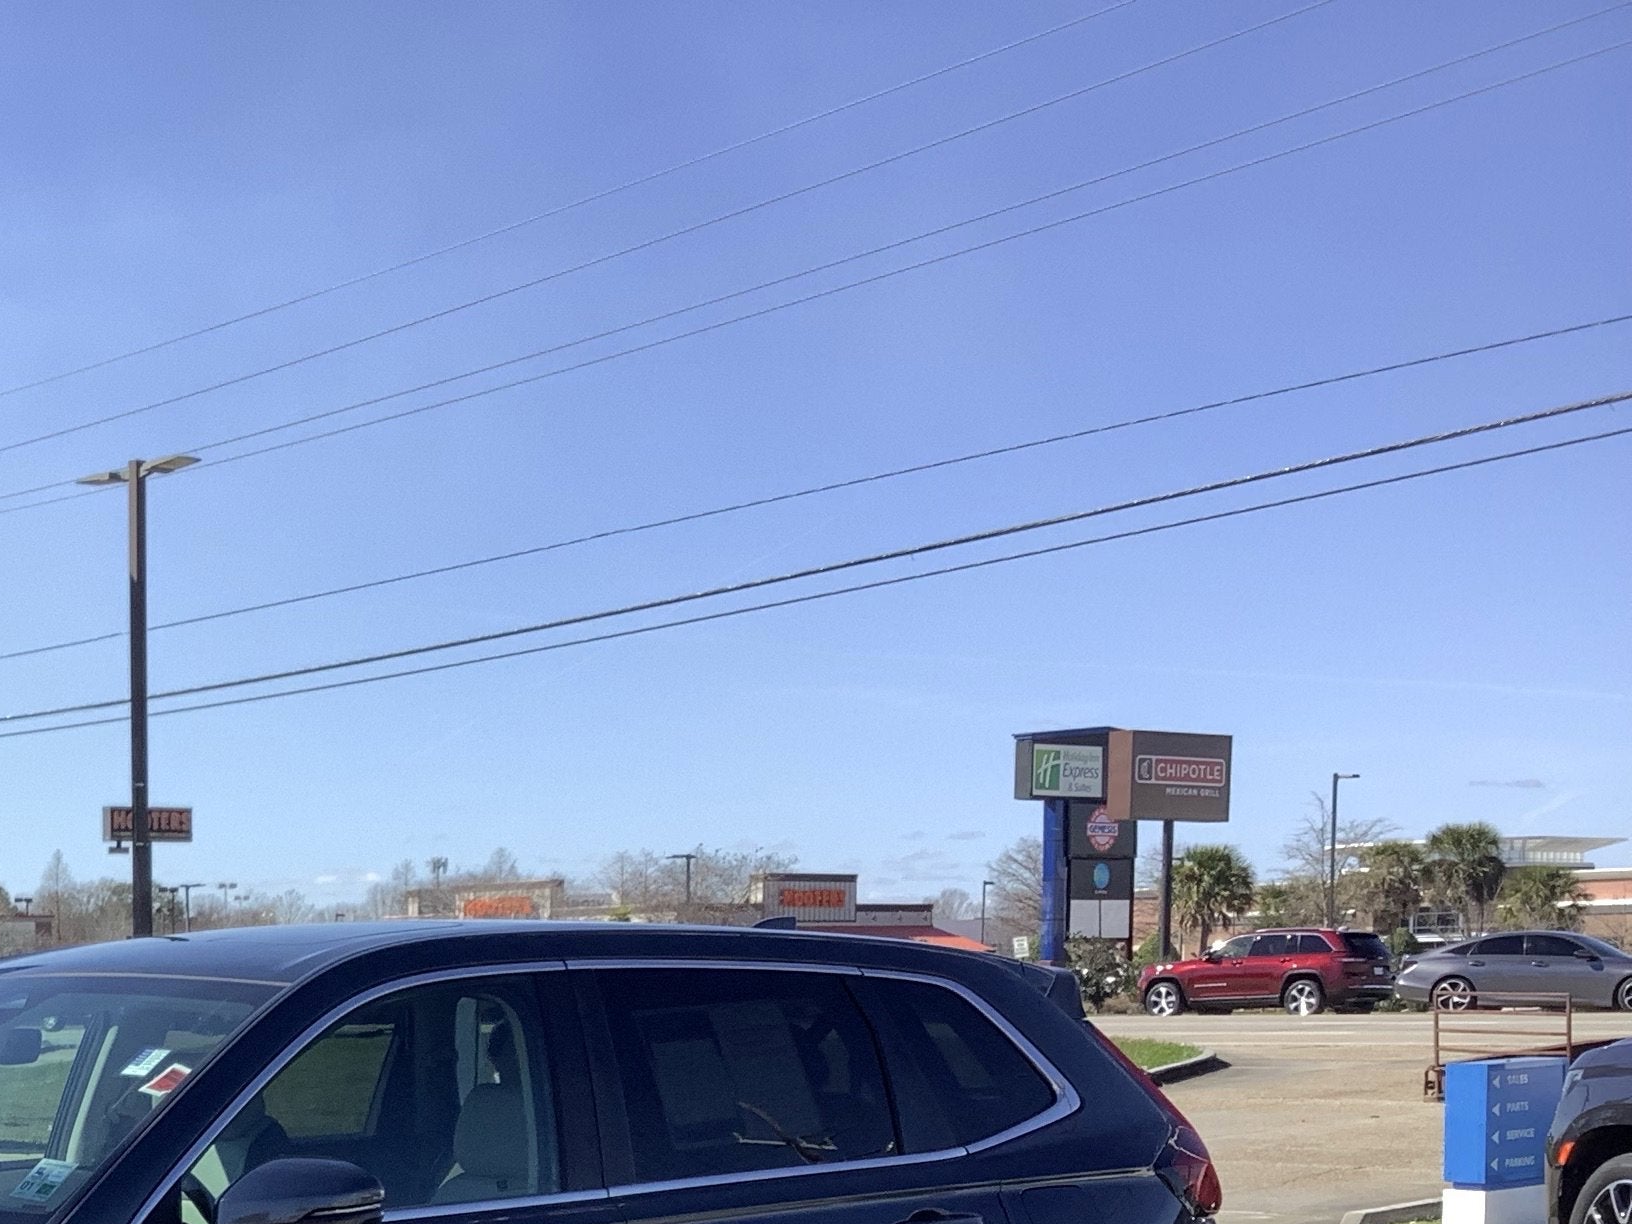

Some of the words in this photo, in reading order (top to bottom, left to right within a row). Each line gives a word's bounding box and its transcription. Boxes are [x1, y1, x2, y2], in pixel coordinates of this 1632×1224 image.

[1063, 762, 1099, 781] Express
[1157, 763, 1221, 780] CHIPOTLE
[1074, 783, 1092, 792] Suites
[1166, 787, 1198, 797] MEXICAN
[1200, 788, 1220, 798] GRILL
[1507, 1074, 1528, 1084] SALES
[1506, 1102, 1528, 1112] PARTS
[1506, 1128, 1535, 1140] SERVICE
[1505, 1156, 1535, 1168] PARKING
